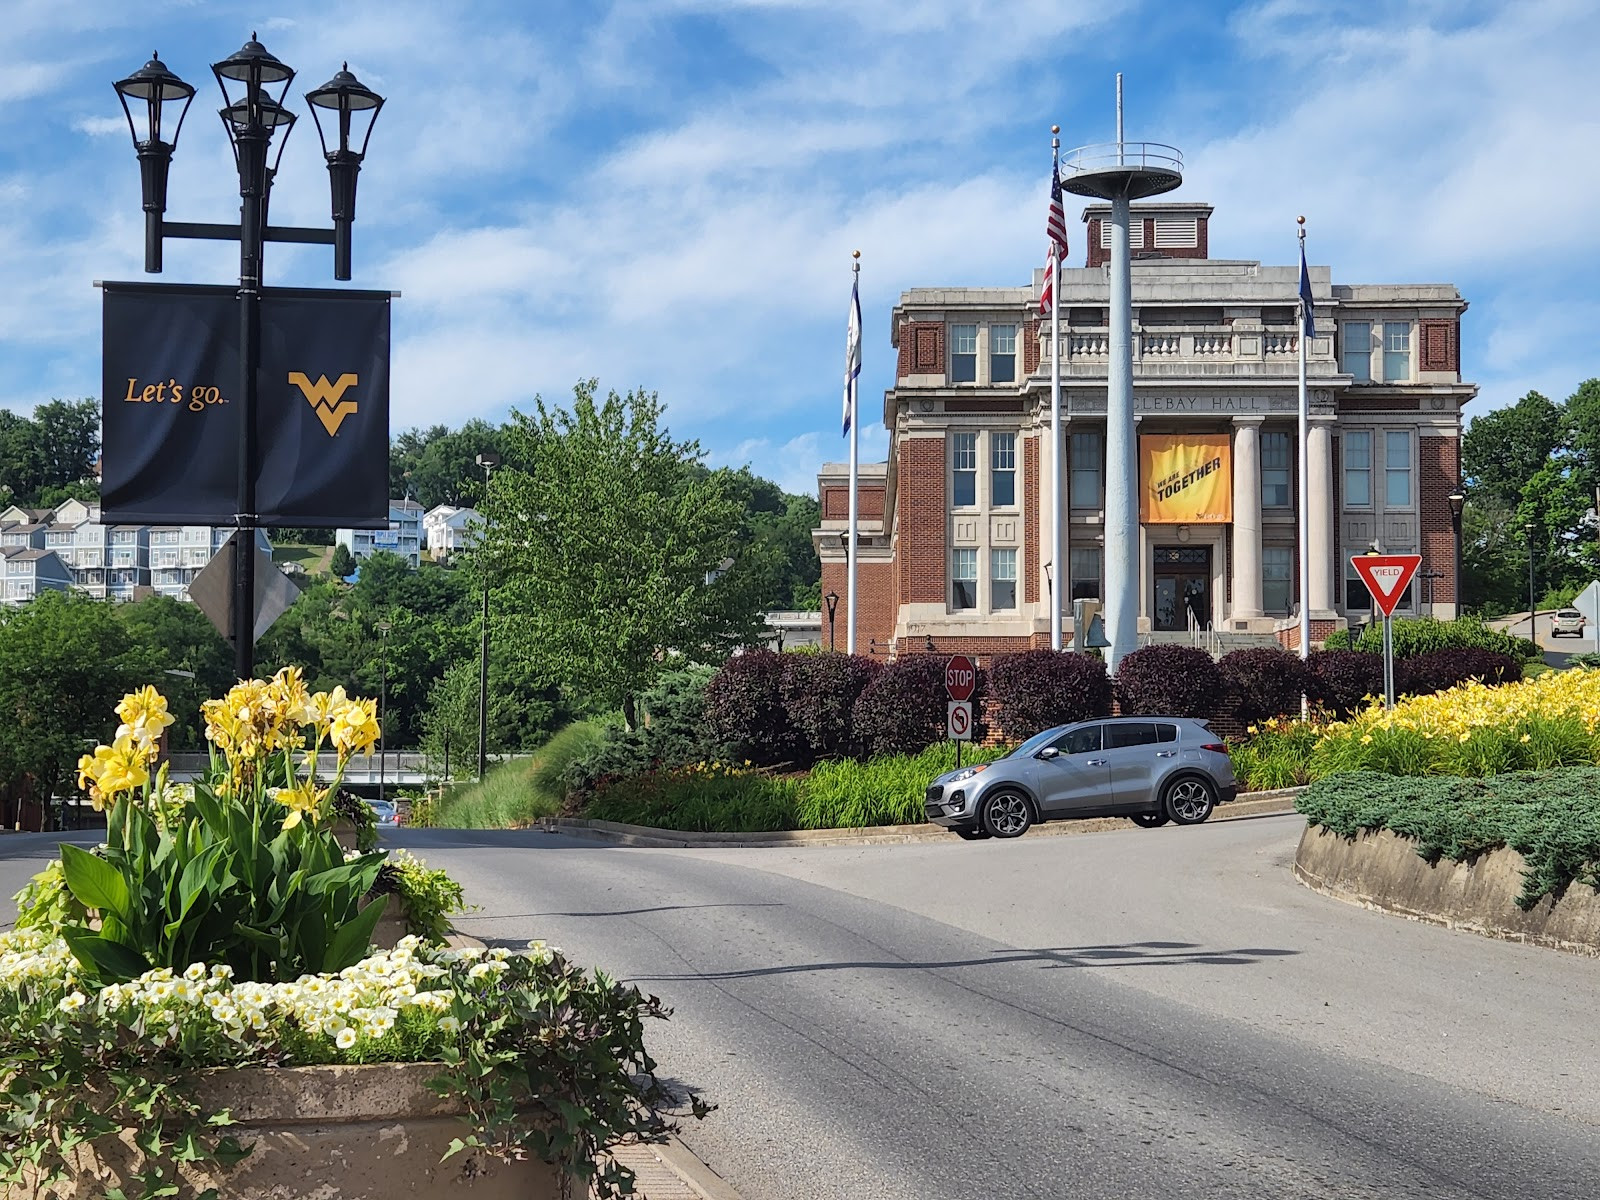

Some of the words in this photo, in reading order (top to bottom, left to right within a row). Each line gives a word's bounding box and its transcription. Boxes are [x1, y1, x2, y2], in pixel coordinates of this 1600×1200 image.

[124, 378, 184, 403] Let's
[188, 386, 224, 412] go.
[1212, 397, 1261, 410] HALL
[1157, 478, 1167, 489] WE
[1168, 470, 1180, 483] ARE
[1157, 456, 1221, 503] TOGETHER
[1374, 568, 1400, 576] YIELD
[947, 669, 973, 687] STOP
